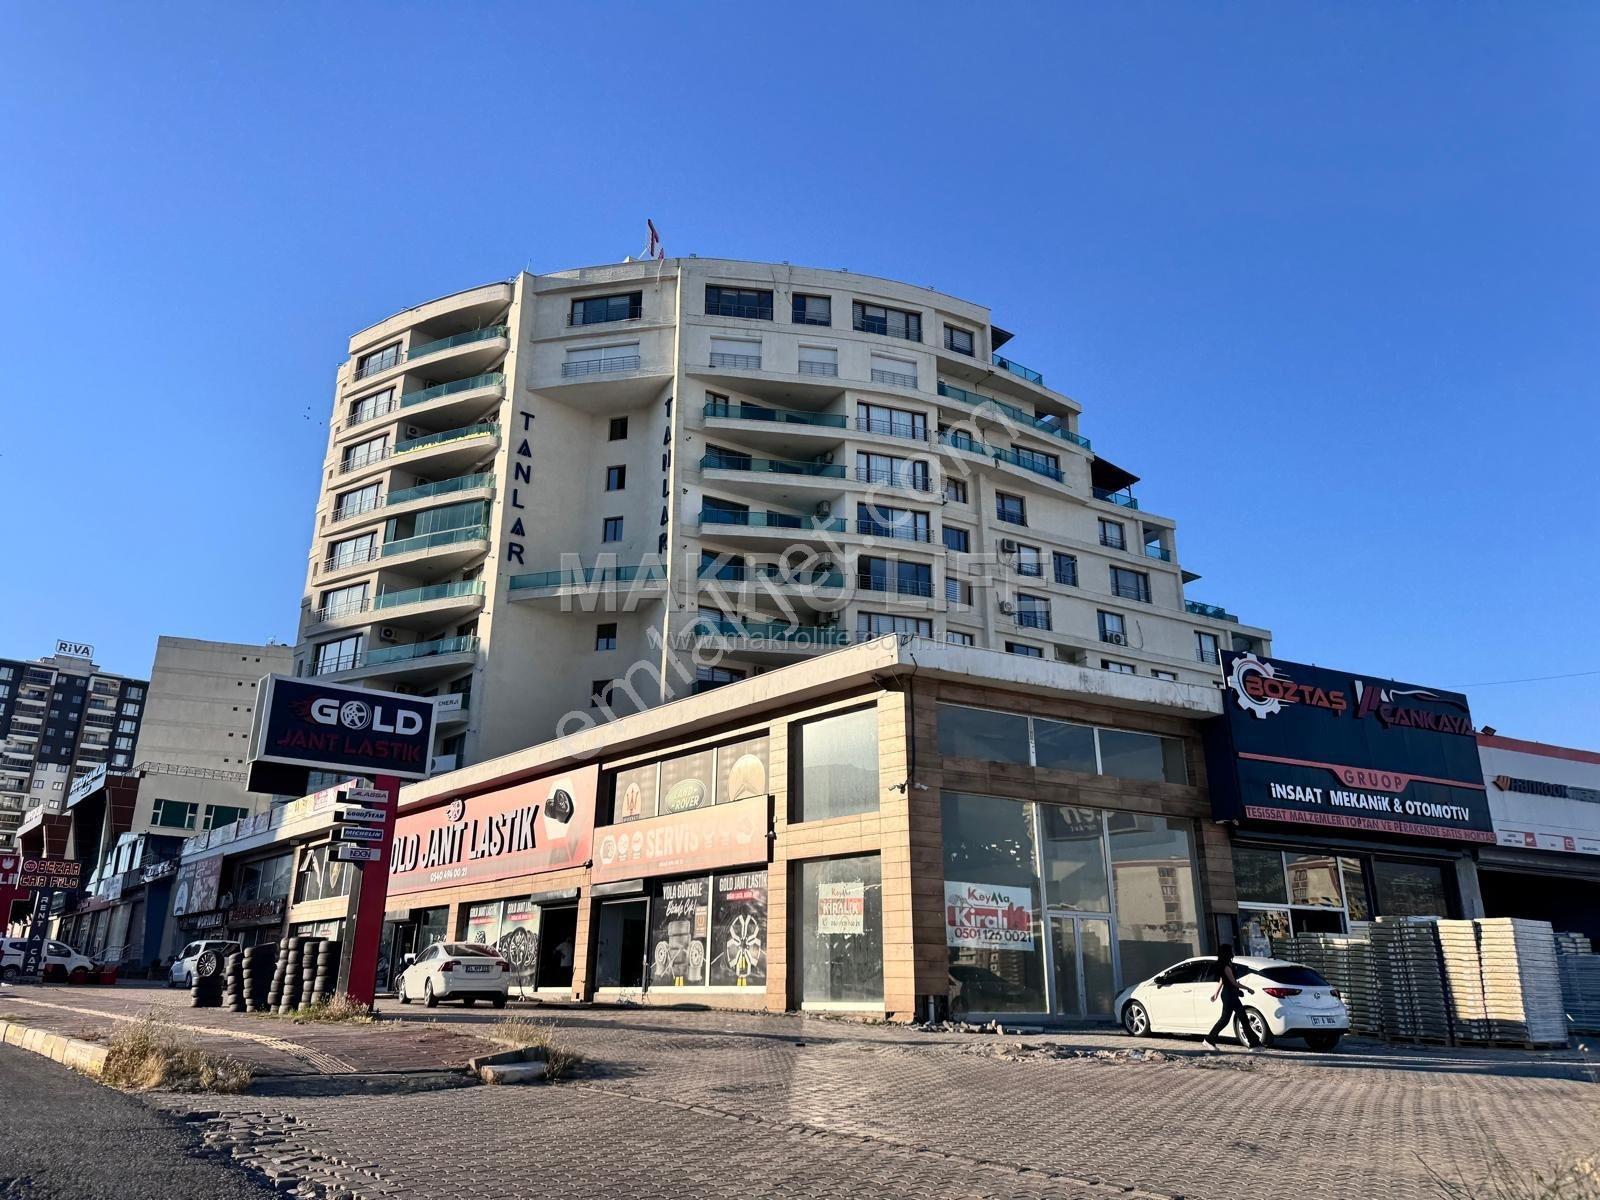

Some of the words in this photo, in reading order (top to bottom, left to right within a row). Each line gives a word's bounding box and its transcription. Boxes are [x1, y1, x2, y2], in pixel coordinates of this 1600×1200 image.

[507, 411, 535, 565] TANLAR
[310, 698, 423, 736] GOLD
[277, 728, 339, 752] JANT
[1344, 769, 1403, 789] GRUOP
[675, 795, 699, 810] ROVER
[1393, 798, 1404, 814] &
[391, 834, 420, 875] OLD
[421, 822, 468, 869] JANT
[469, 805, 540, 860] LASTIK
[37, 897, 48, 927] RENT
[1004, 930, 1031, 942] 0021
